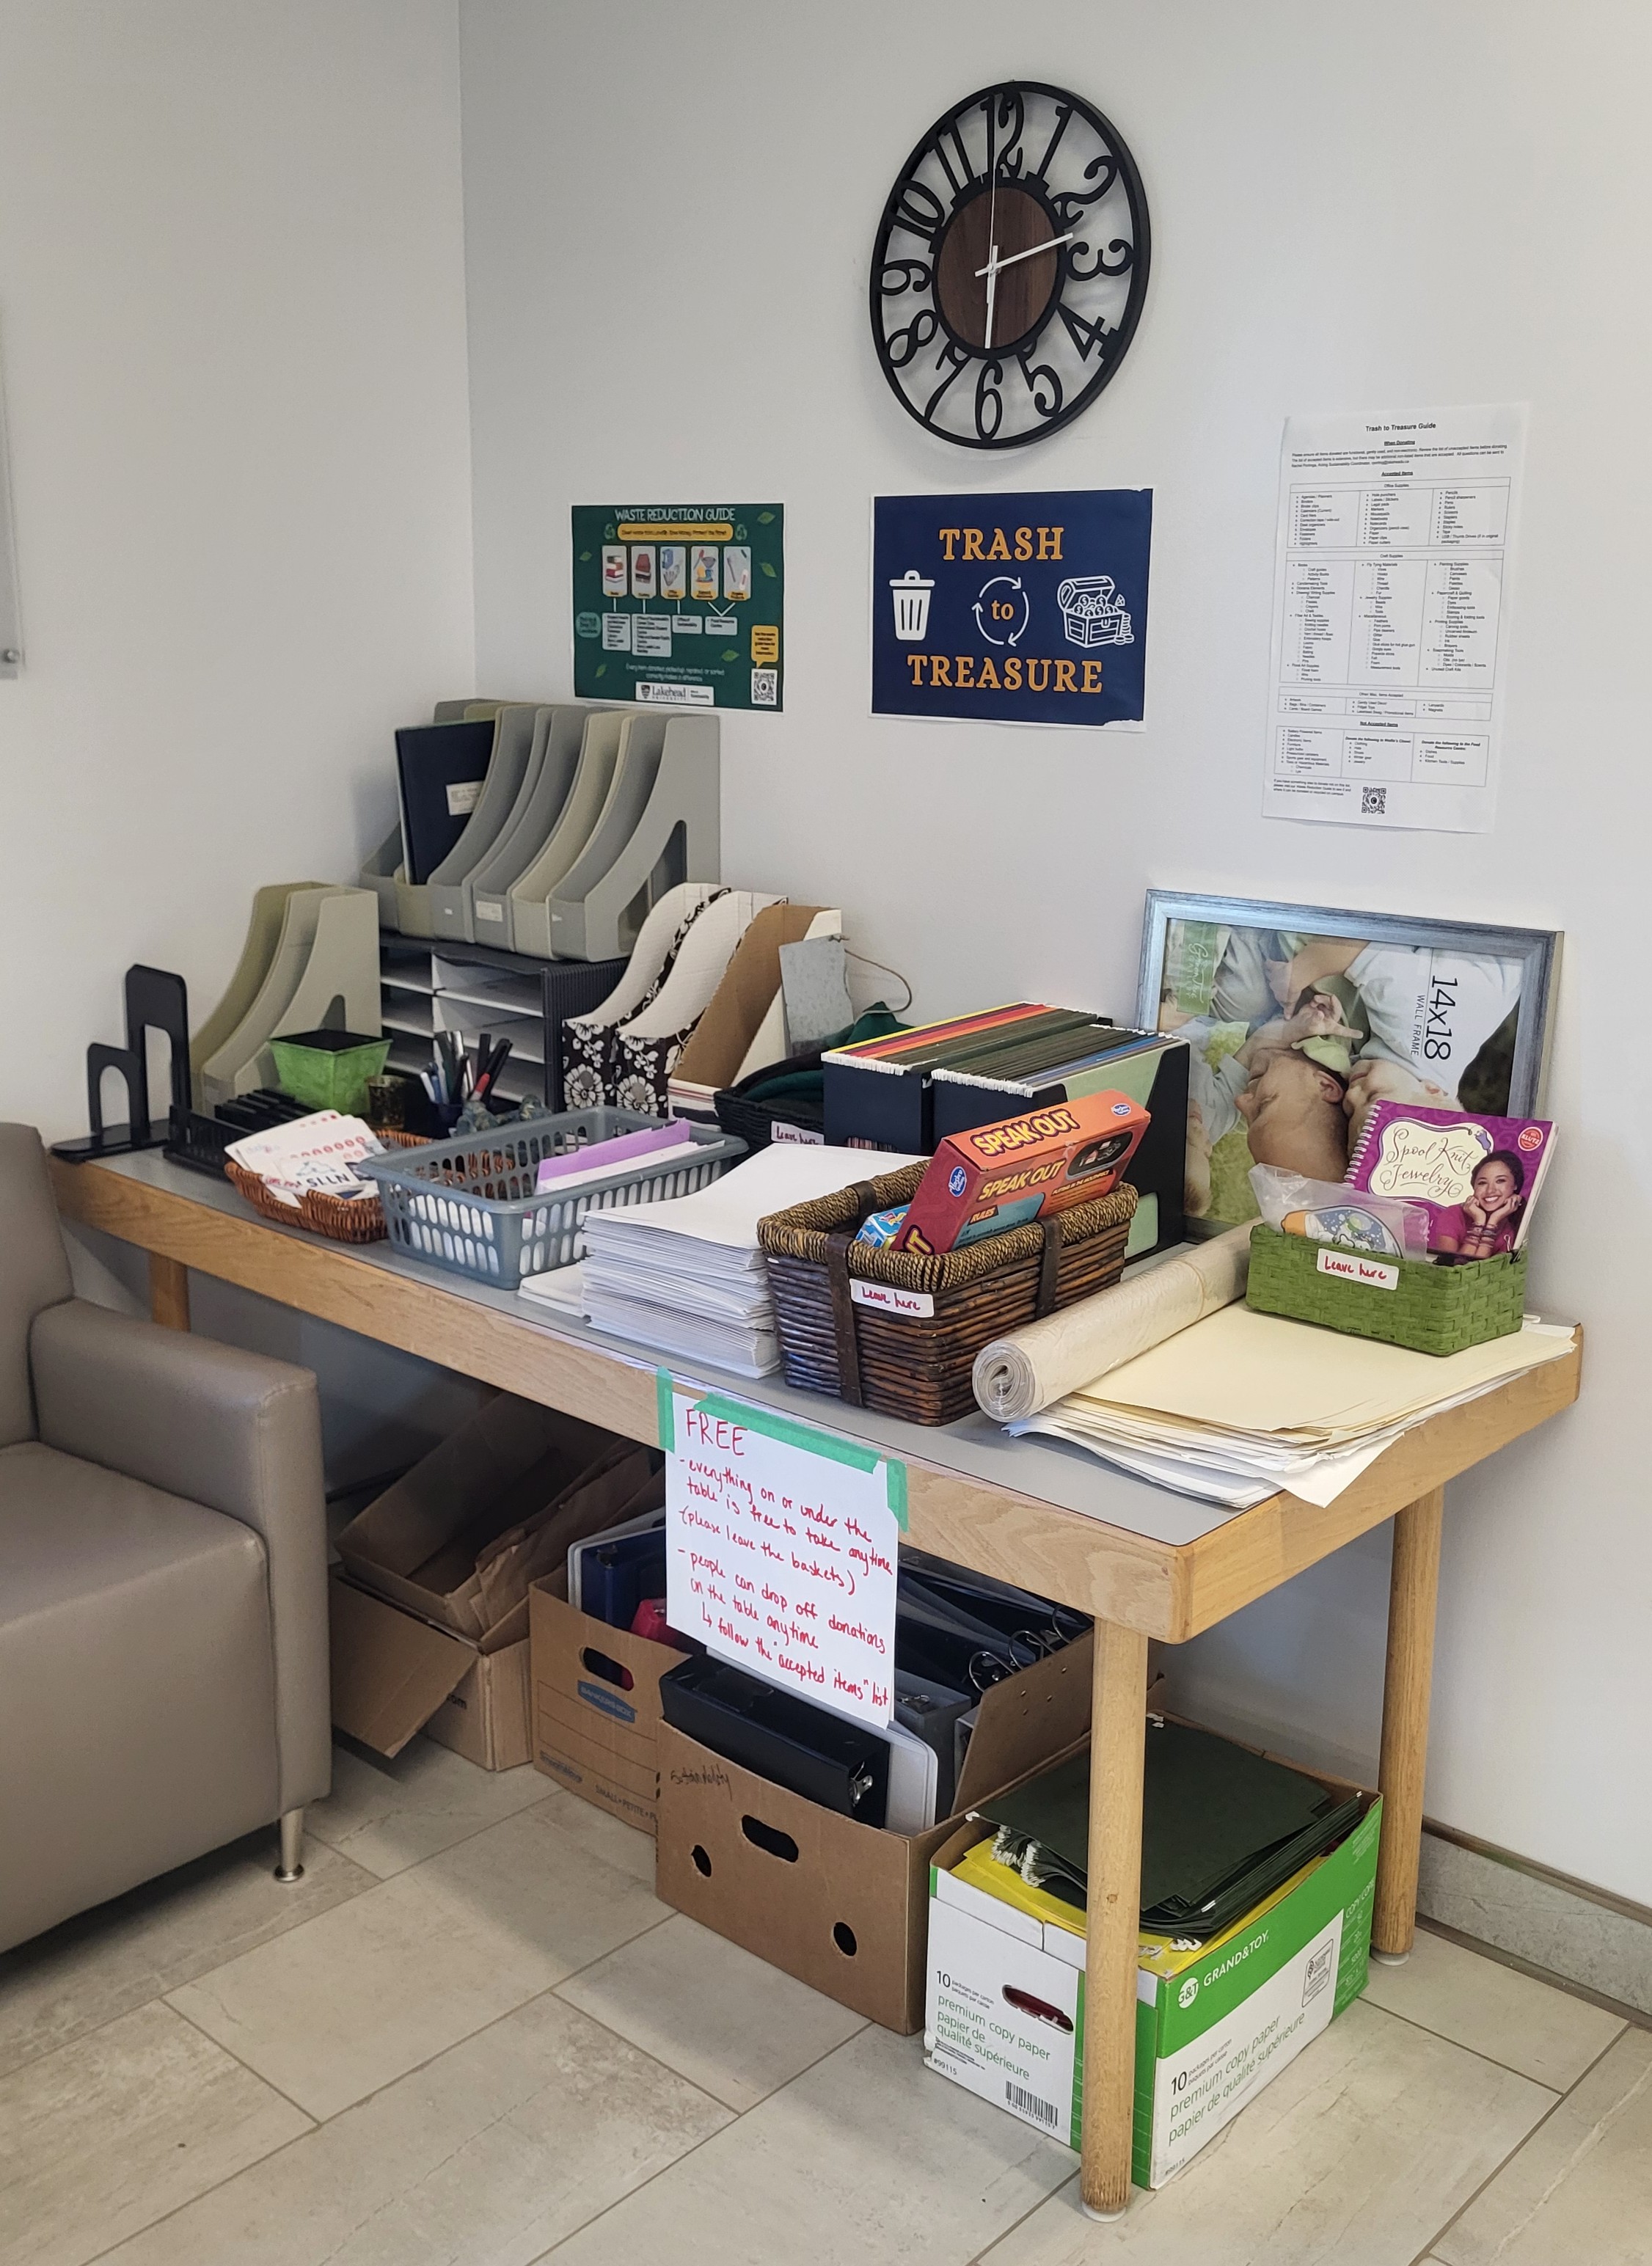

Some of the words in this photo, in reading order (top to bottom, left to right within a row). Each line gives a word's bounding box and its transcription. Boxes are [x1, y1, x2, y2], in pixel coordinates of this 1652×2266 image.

[928, 117, 976, 191] 11
[980, 91, 1024, 178] 12
[1038, 105, 1074, 180] 1
[890, 180, 945, 248] 10
[1050, 155, 1120, 228] 2
[880, 258, 932, 296] 9
[1065, 238, 1134, 281] 3
[886, 309, 940, 368] 8
[1055, 301, 1125, 362] 4
[924, 340, 972, 422] 7
[975, 359, 1004, 440] 6
[1016, 336, 1064, 417] 5
[1365, 424, 1382, 432] Trash
[615, 508, 646, 521] WASTE
[647, 508, 703, 522] REDUCTION
[706, 508, 736, 521] GUIDE
[939, 527, 1064, 560] TRASH
[992, 600, 1014, 621] to
[652, 685, 686, 698] Lakehead
[907, 654, 1102, 693] TREASURE
[1414, 995, 1425, 1020] WALL
[1424, 975, 1458, 1060] 14x18
[1411, 1024, 1422, 1056] FRAME
[973, 1120, 1036, 1155] SPEAK
[1034, 1110, 1080, 1137] OUT
[1386, 1127, 1436, 1169] Spool
[1426, 1137, 1479, 1174] Knit
[1521, 1133, 1540, 1144] KLUTZ
[977, 1169, 1028, 1202] SPEAK
[1029, 1161, 1066, 1186] OUT
[1379, 1165, 1464, 1197] Jewelry
[969, 1207, 996, 1224] RULES
[1325, 1255, 1354, 1273] Leave
[1359, 1262, 1387, 1279] here
[893, 1292, 921, 1310] here
[686, 1408, 748, 1455] FREE
[687, 1477, 718, 1502] table
[726, 1494, 740, 1515] is
[750, 1503, 780, 1529] free
[783, 1518, 797, 1535] to
[805, 1526, 841, 1552] take
[849, 1547, 893, 1576] anytime
[761, 1487, 775, 1503] on
[782, 1496, 792, 1509] or
[800, 1504, 838, 1527] under
[844, 1518, 871, 1543] the
[727, 1524, 756, 1550] leave
[761, 1541, 784, 1562] the
[792, 1552, 855, 1596] baskets)
[690, 1552, 726, 1579] people
[735, 1574, 755, 1593] can
[761, 1583, 787, 1612] drop
[796, 1602, 818, 1620] off
[829, 1614, 885, 1654] donations
[690, 1578, 703, 1594] on
[708, 1584, 726, 1604] the
[733, 1595, 759, 1620] table
[767, 1615, 819, 1649] anytime
[718, 1618, 749, 1648] follow
[756, 1637, 772, 1661] the
[872, 1681, 888, 1706] list
[936, 1970, 951, 1988] 10
[1178, 1982, 1199, 2003] G&T
[1203, 1930, 1269, 1987] GRAND&TOY
[938, 2011, 970, 2034] papier
[971, 2028, 986, 2043] de
[938, 1995, 986, 2027] premium
[989, 2022, 1015, 2044] copy
[1018, 2036, 1050, 2061] paper
[934, 2058, 957, 2075] #99115
[937, 2024, 973, 2049] qualité
[974, 2043, 1030, 2080] supérieure
[1170, 2069, 1223, 2123] premium
[1226, 2044, 1249, 2075] copy
[1251, 2015, 1281, 2054] paper
[1169, 2105, 1206, 2147] papier
[1207, 2093, 1221, 2112] de
[1223, 2060, 1255, 2098] qualité
[1257, 2012, 1305, 2065] supérieure
[1171, 2071, 1187, 2096] 10
